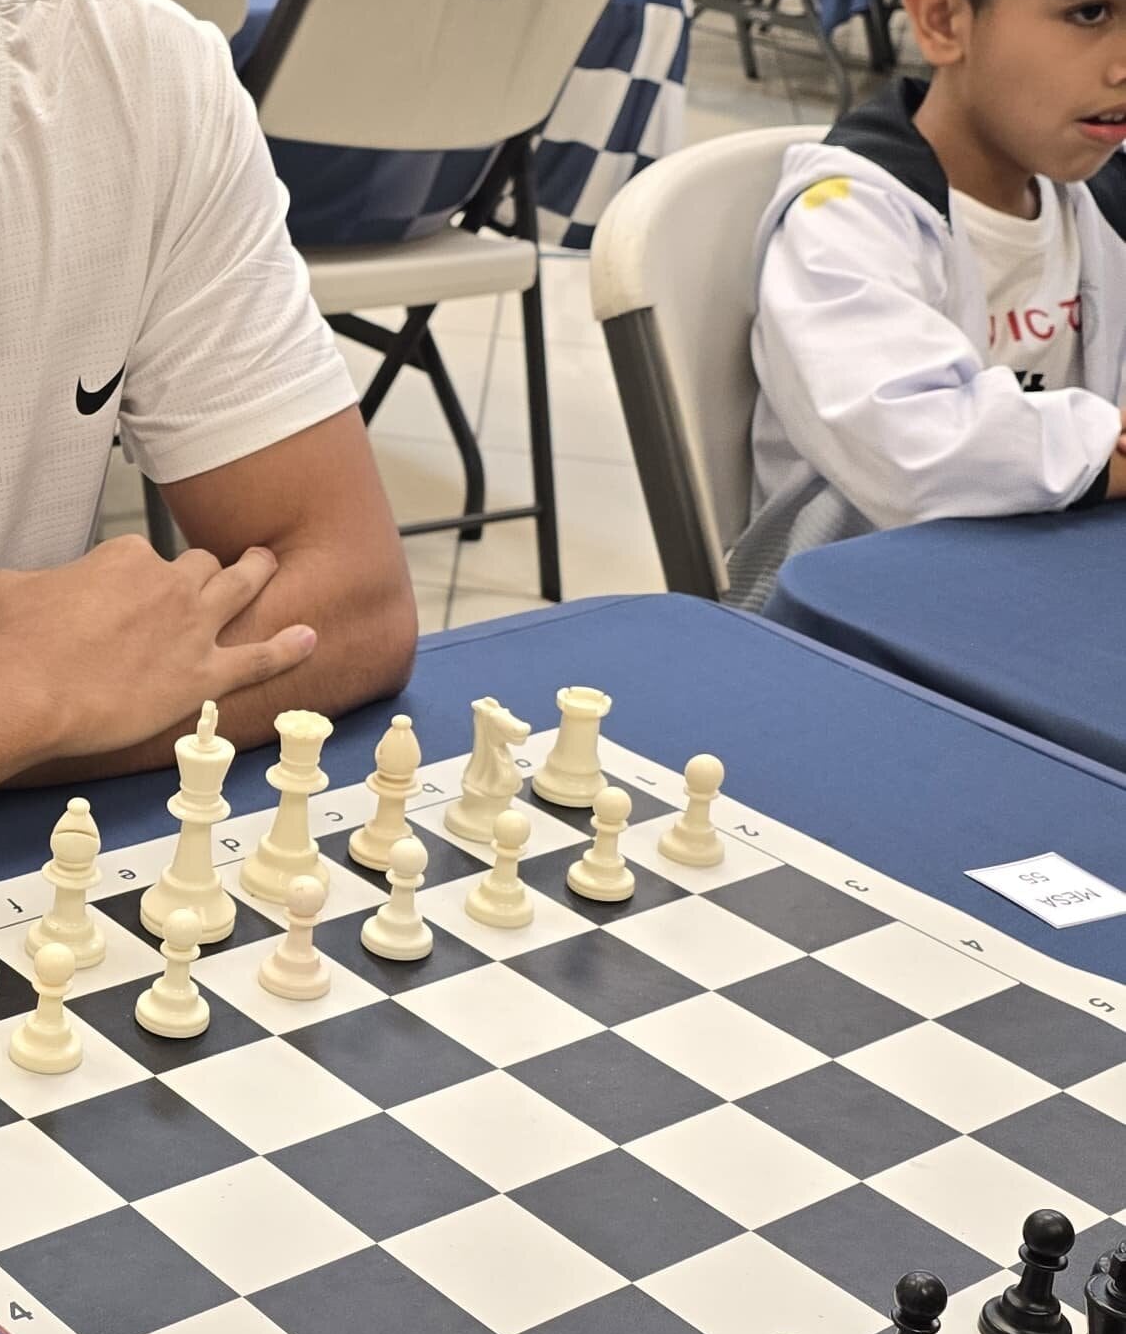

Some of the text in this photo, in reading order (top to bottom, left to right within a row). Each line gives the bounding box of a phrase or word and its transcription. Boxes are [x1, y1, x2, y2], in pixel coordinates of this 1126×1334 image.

[1018, 871, 1051, 885] 55
[1035, 887, 1103, 908] MESA
[734, 824, 760, 838] 2
[844, 879, 870, 894] 3
[959, 939, 985, 953] 4
[1088, 997, 1117, 1013] 5
[9, 1299, 34, 1323] 4
